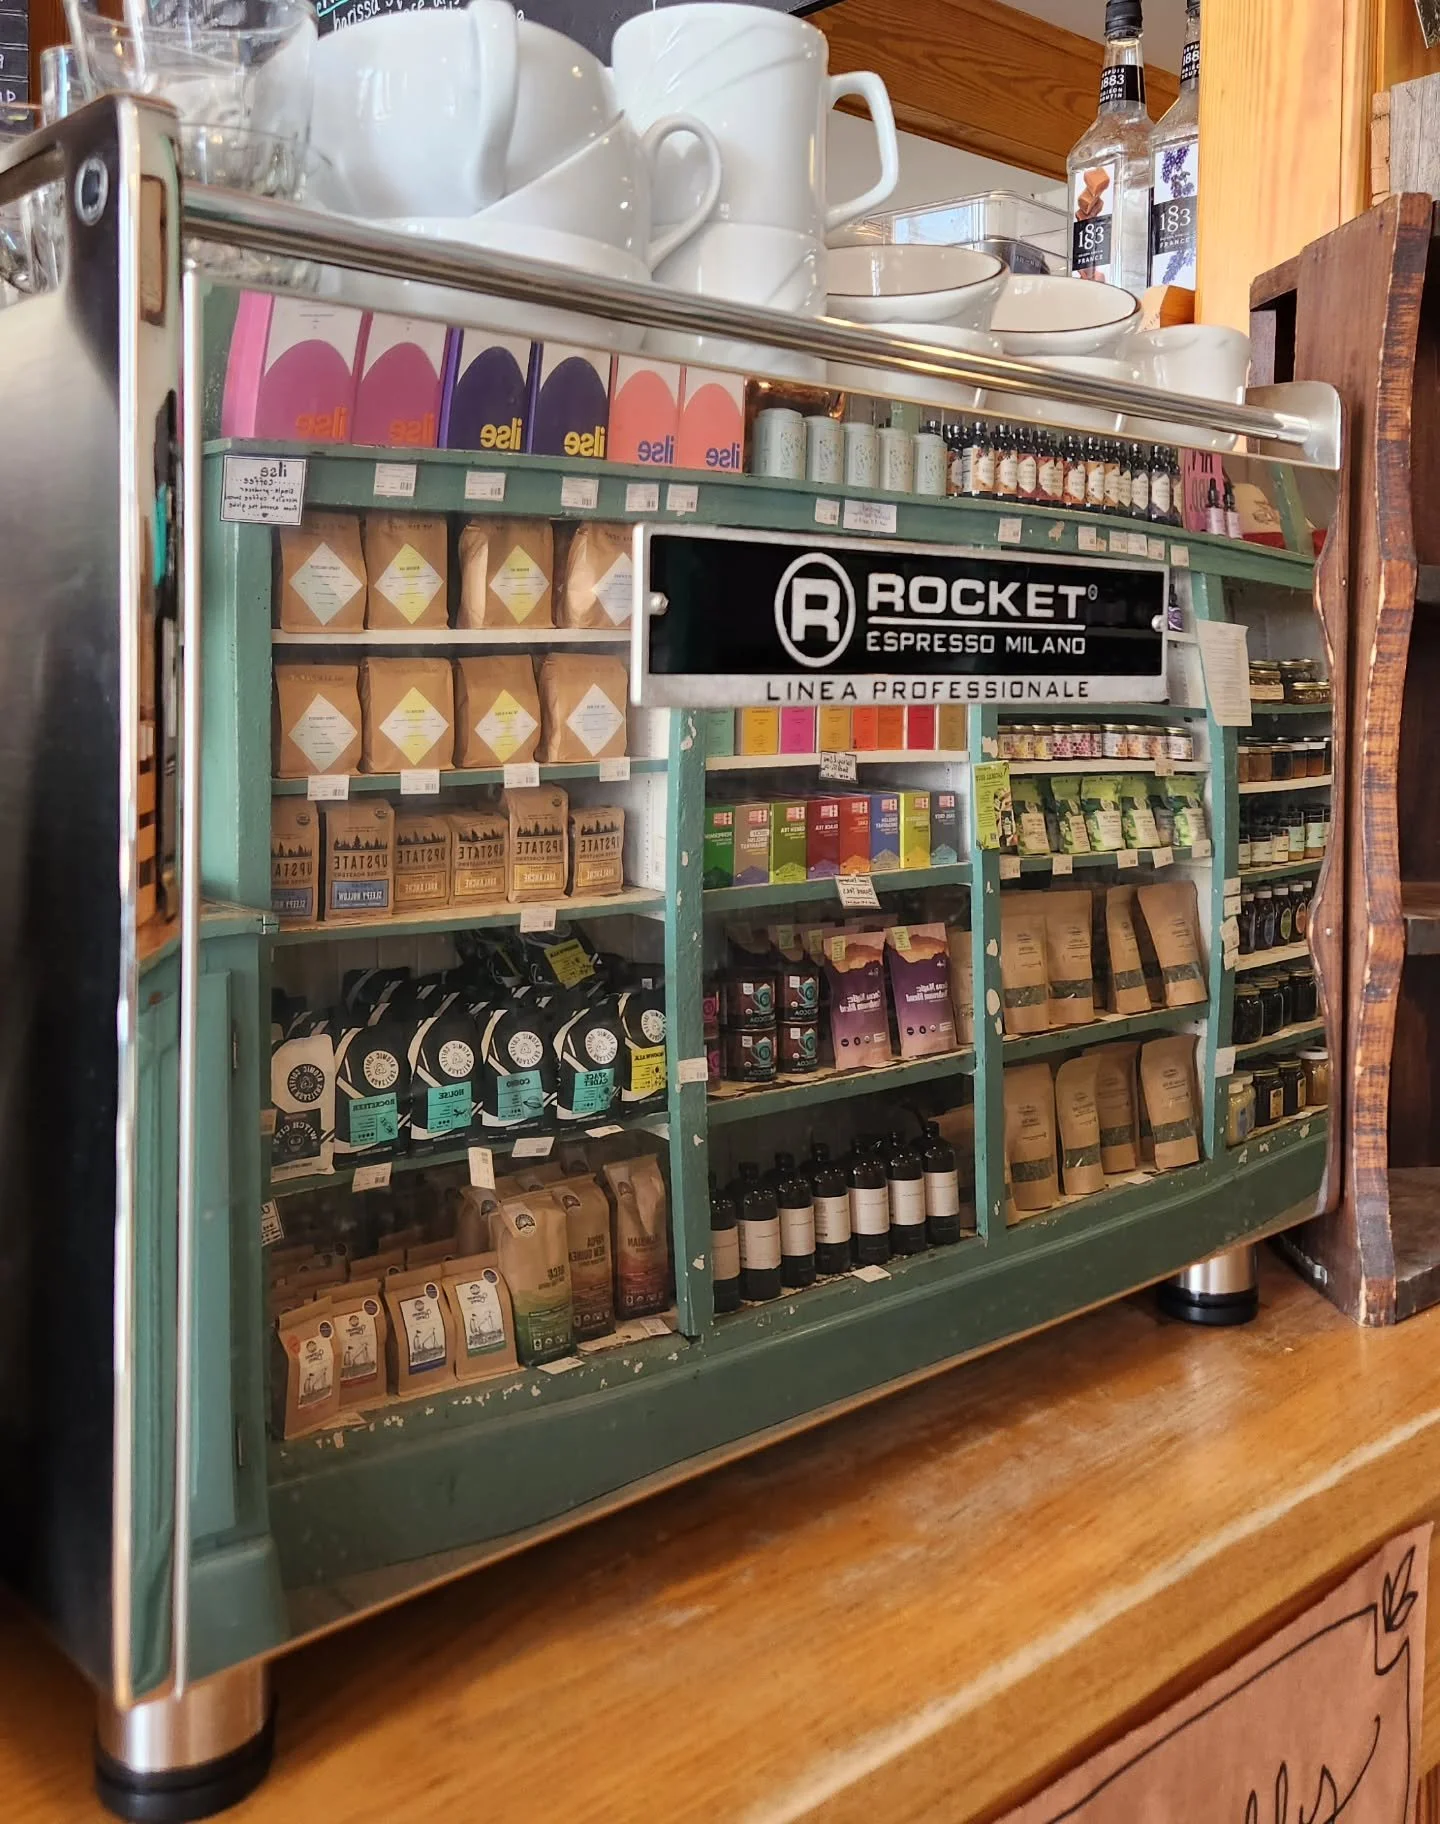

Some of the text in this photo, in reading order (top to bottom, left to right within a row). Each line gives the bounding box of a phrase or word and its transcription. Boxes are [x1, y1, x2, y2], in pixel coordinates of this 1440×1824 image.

[1183, 50, 1200, 66] 188
[1100, 74, 1125, 90] 1883
[1160, 205, 1191, 233] 1883
[1078, 223, 1105, 250] 1883
[1159, 237, 1191, 248] FRANCE
[1077, 254, 1104, 265] FRANCE
[866, 571, 1087, 619] ROCKET
[866, 631, 1087, 657] ESPRESSO MILANO
[766, 680, 1090, 703] LINEA PROFESSIONALE
